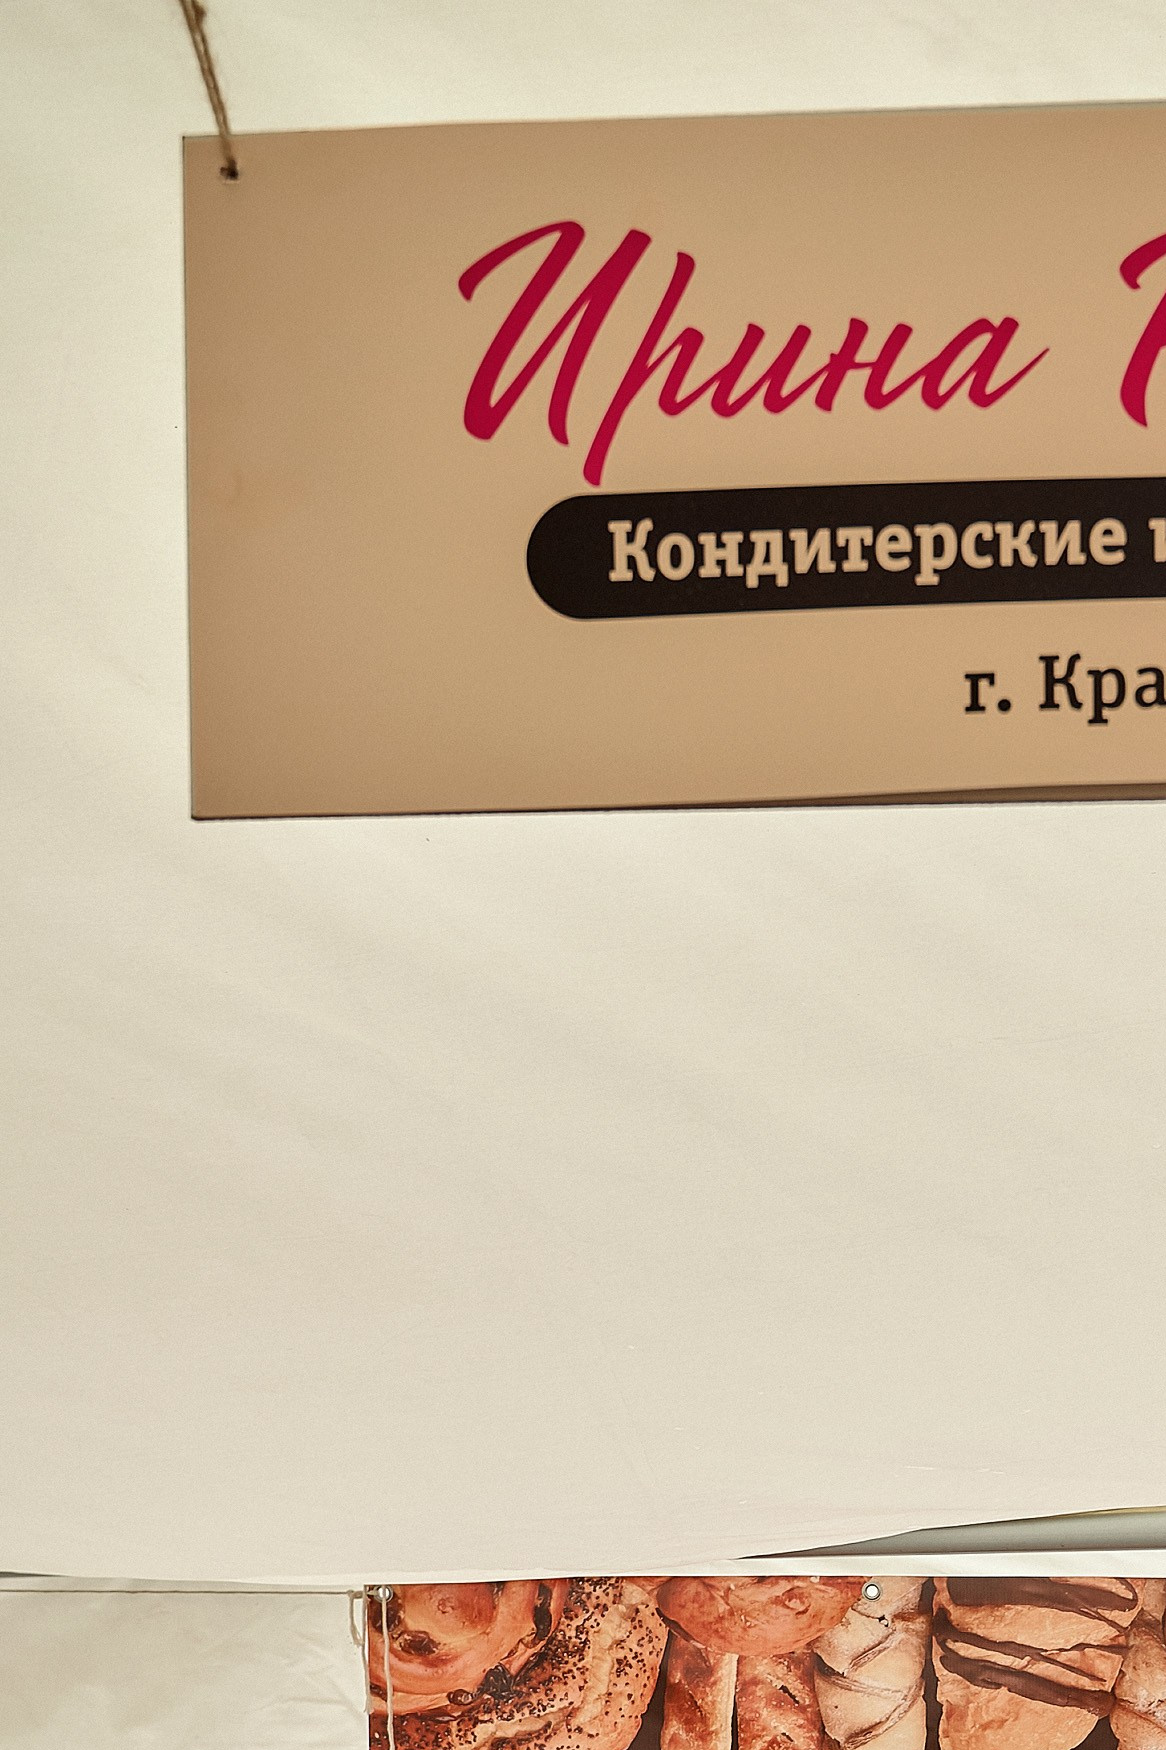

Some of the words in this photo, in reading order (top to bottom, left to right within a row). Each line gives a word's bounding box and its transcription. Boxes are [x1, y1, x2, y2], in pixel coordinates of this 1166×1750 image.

[458, 220, 1049, 487] Ирина
[607, 517, 1128, 588] Кондитерские
[964, 671, 1012, 713] г.
